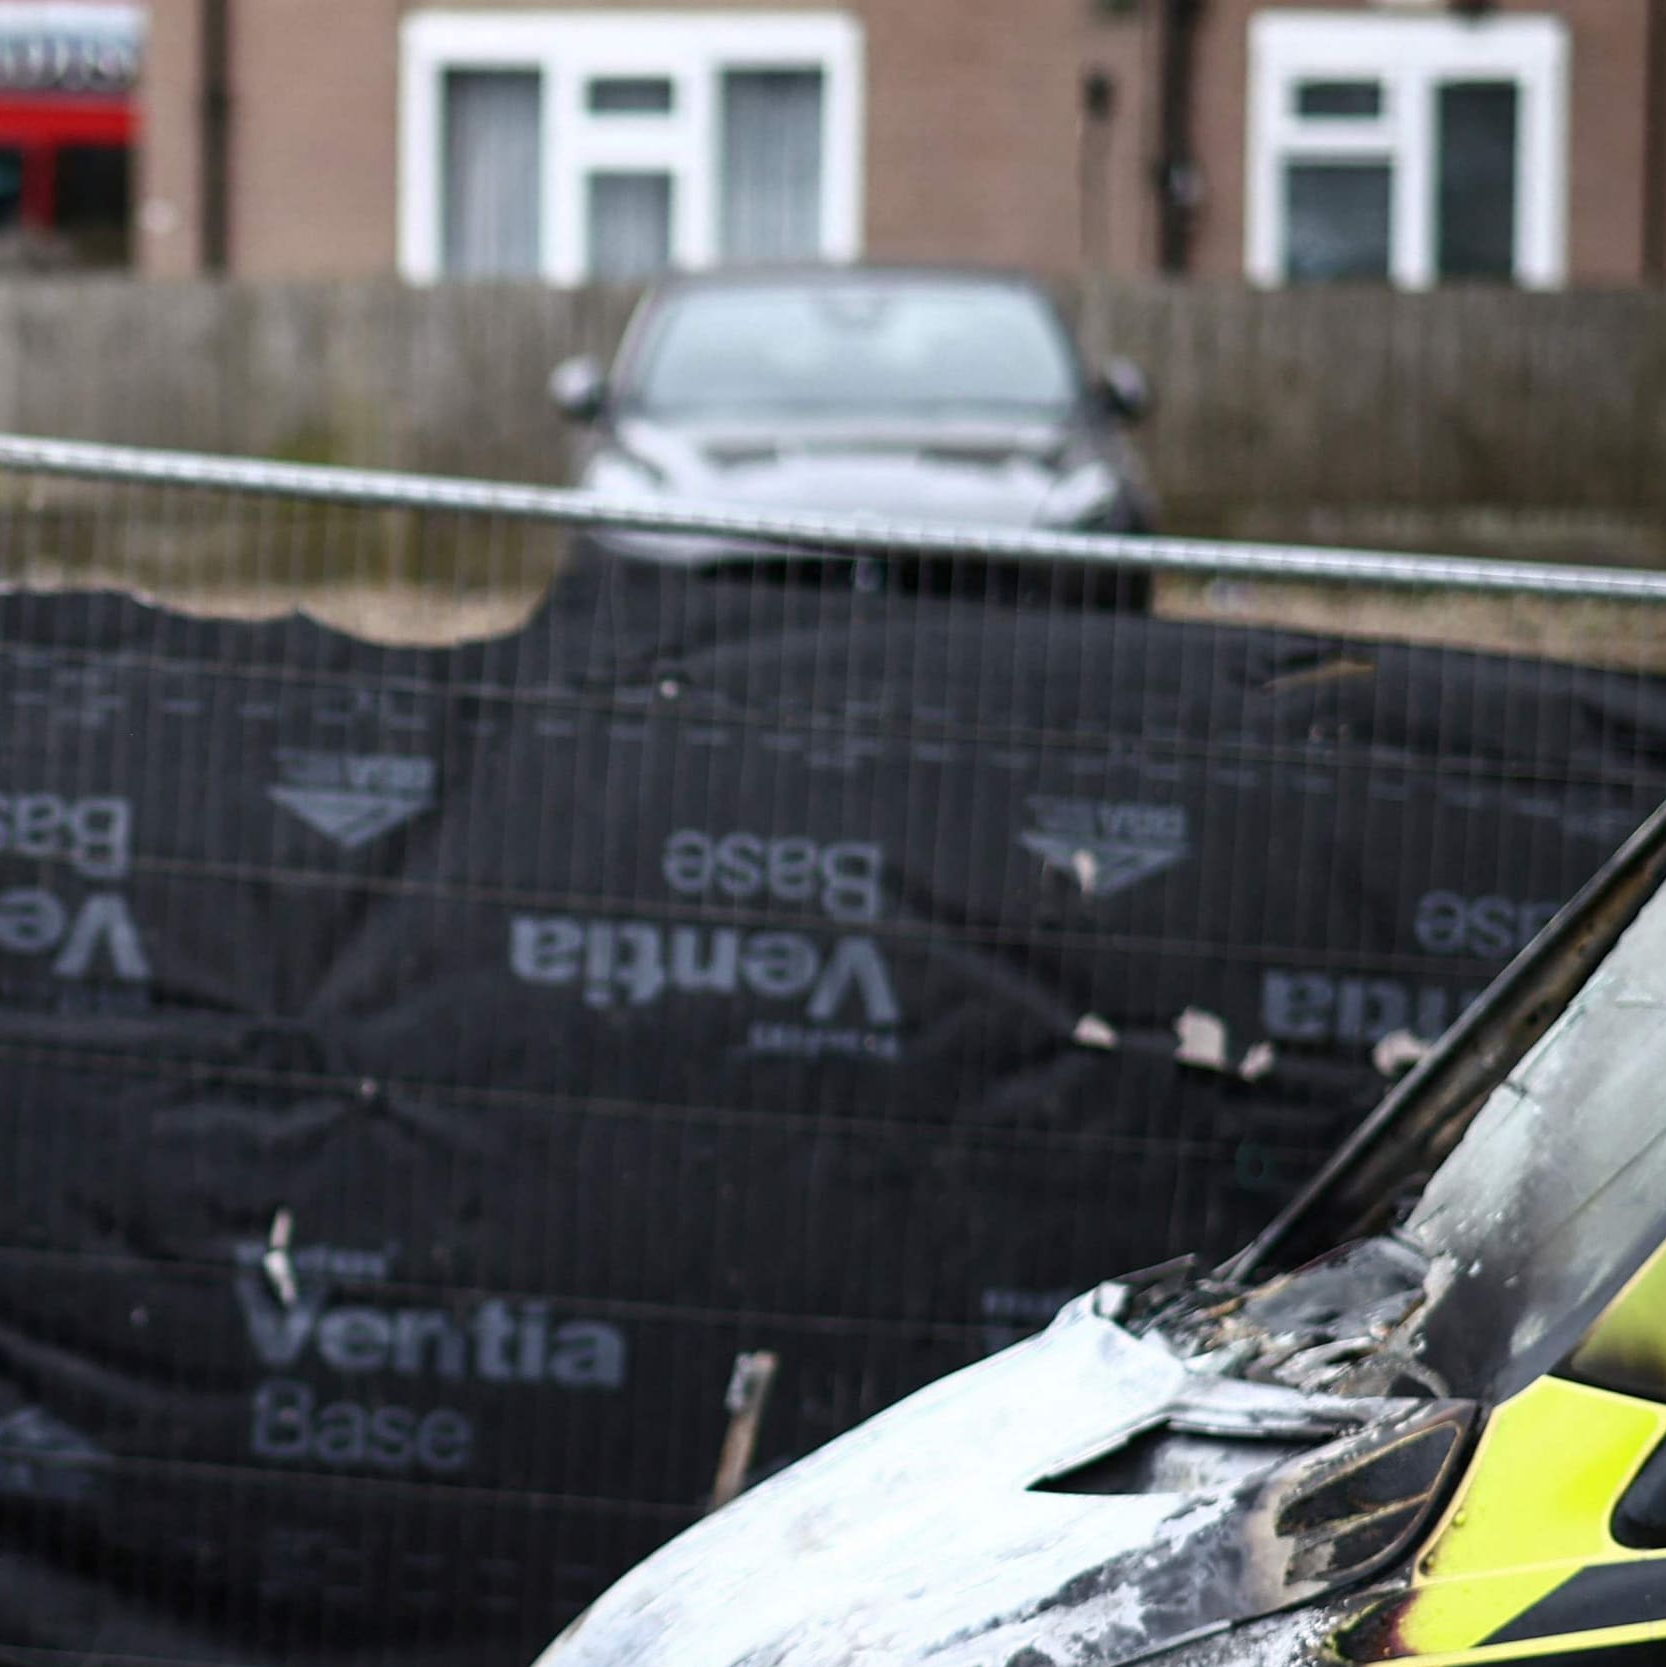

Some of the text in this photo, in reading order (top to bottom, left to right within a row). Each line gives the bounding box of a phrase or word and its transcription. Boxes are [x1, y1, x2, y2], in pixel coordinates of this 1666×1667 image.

[663, 830, 884, 924] Base
[1413, 889, 1559, 958] ase
[510, 916, 901, 1022] Ventia
[237, 1276, 626, 1388] Ventia
[250, 1378, 471, 1468] Base
